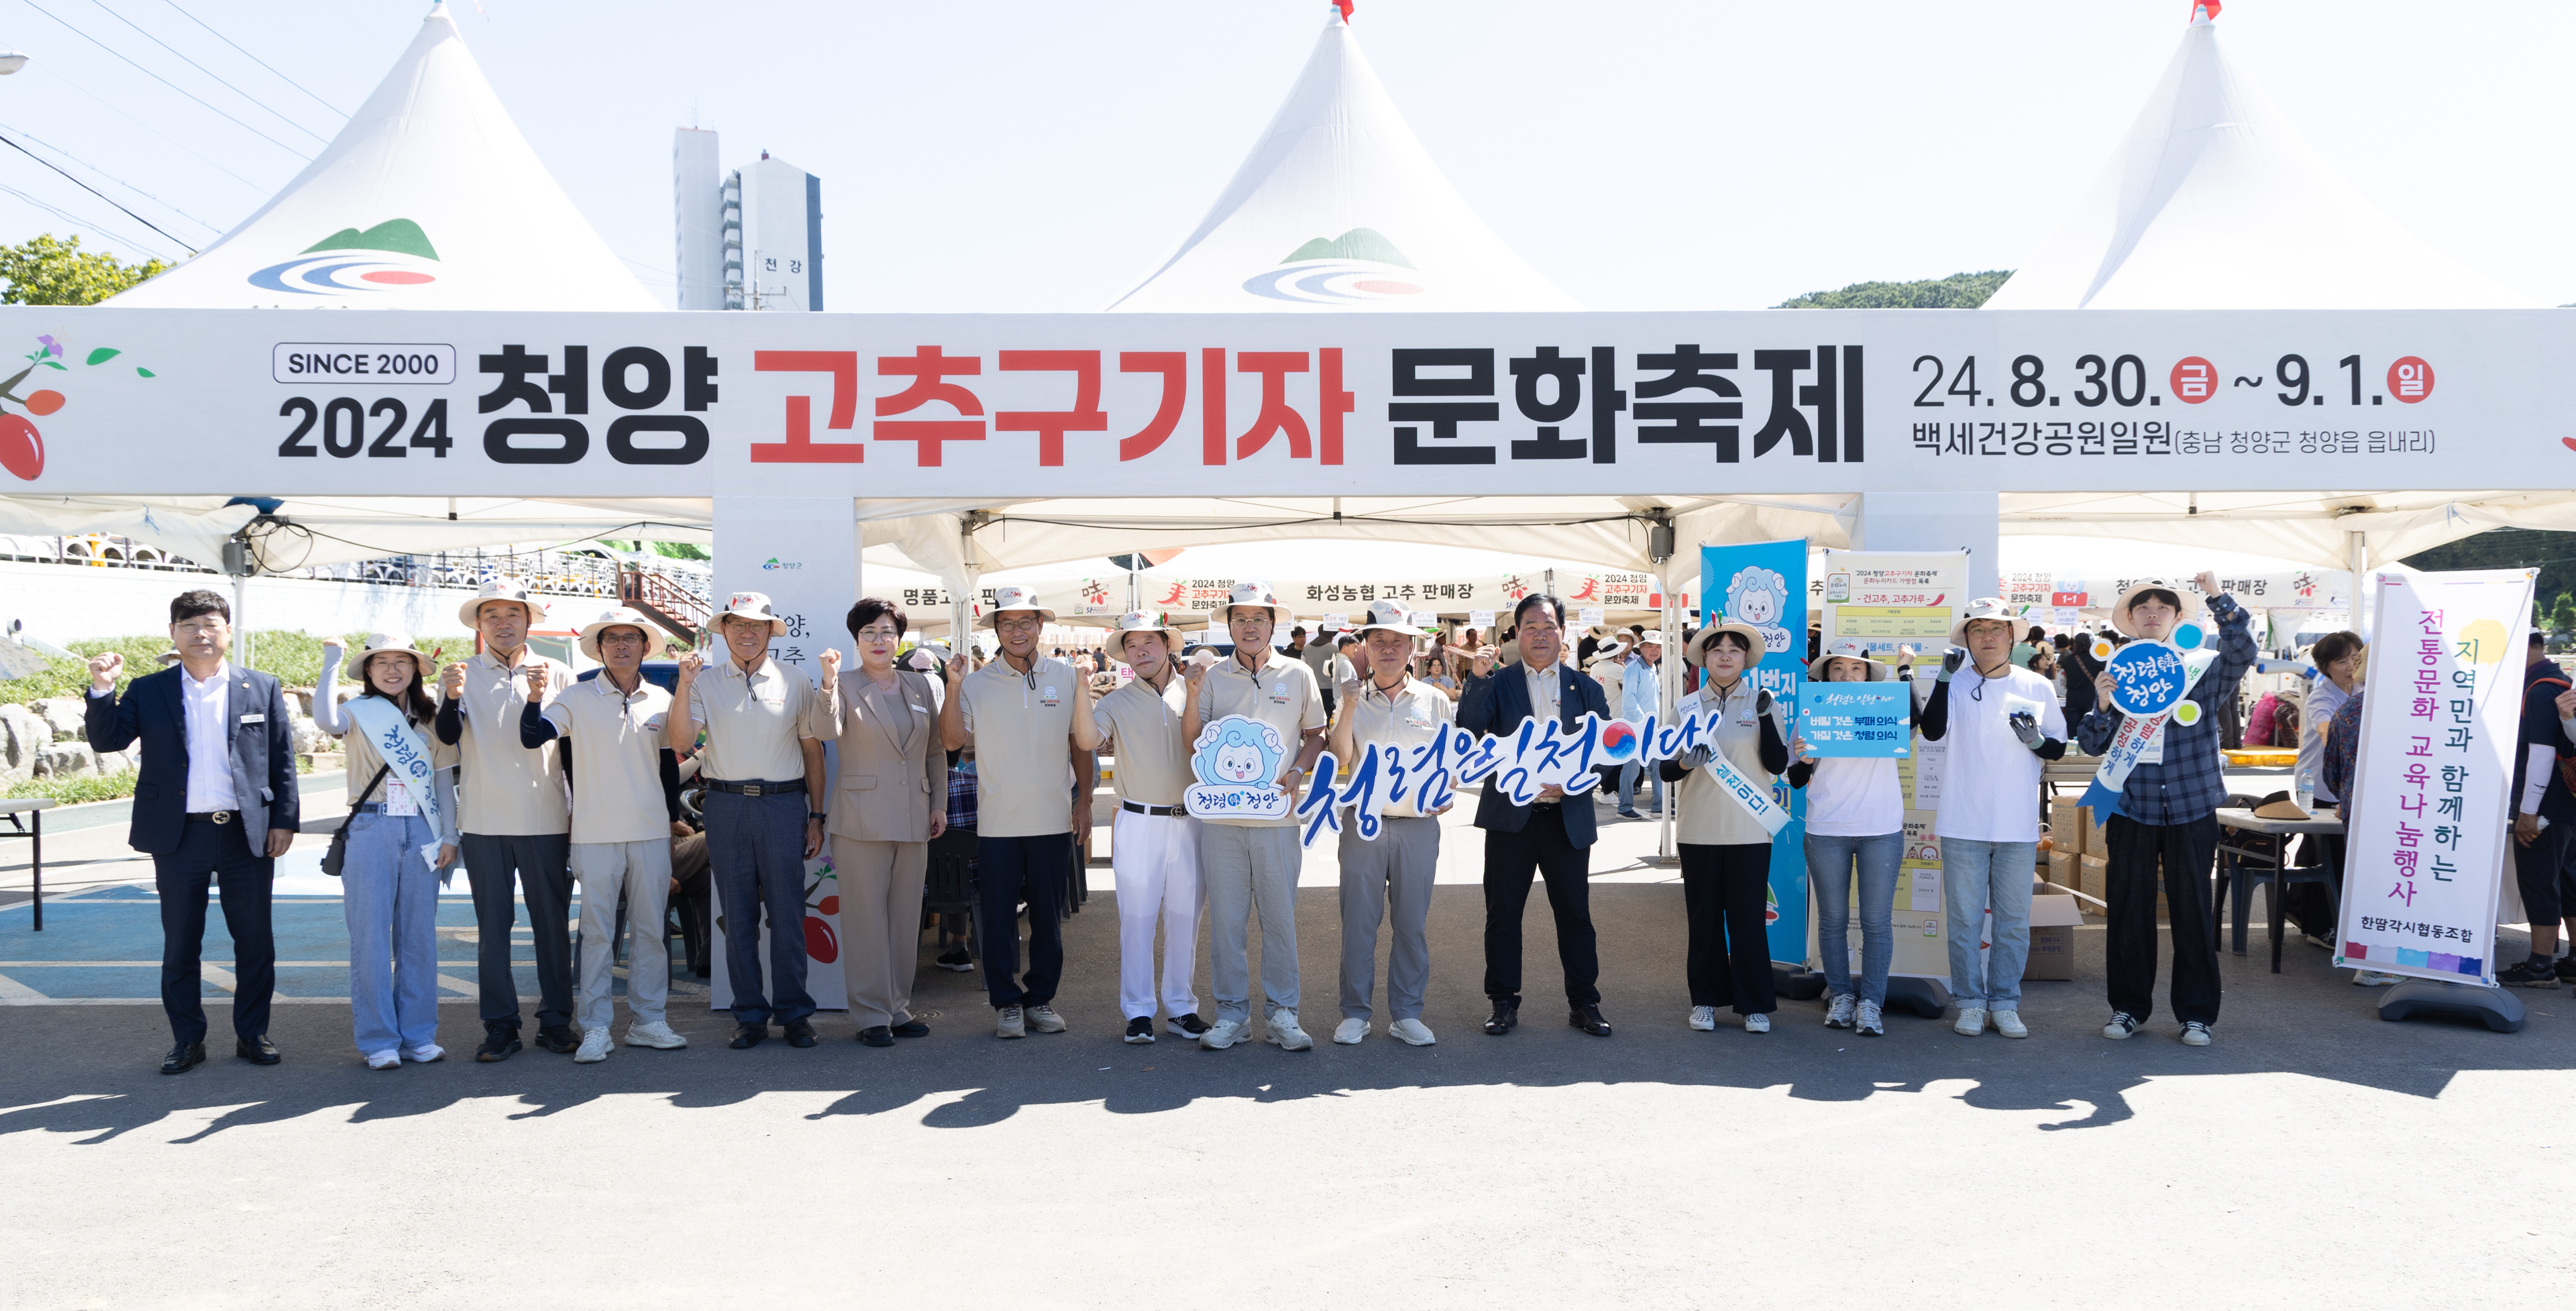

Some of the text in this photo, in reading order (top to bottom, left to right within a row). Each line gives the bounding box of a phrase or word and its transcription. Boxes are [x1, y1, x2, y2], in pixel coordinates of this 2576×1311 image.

[288, 353, 439, 375] SINCE 2000
[1912, 355, 1995, 407] 24.
[2010, 353, 2060, 407] 8.
[2074, 353, 2161, 406] 30.
[2180, 365, 2209, 397] 금
[2275, 353, 2323, 406] 9.
[2339, 353, 2383, 406] 1.
[2398, 363, 2424, 396] 일
[278, 343, 1864, 467] 2024 청양 고추구기자 문화축제
[2229, 429, 2292, 455] 청양군
[2298, 429, 2360, 455] 청양읍
[2367, 429, 2435, 455] 읍내리)
[782, 562, 802, 570] 청양군
[1192, 579, 1235, 588] 2024 청양
[1605, 574, 1647, 583] 2024 청양
[2012, 573, 2051, 581] 2024 청양
[1307, 583, 1474, 602] 화성농협 고추 판매장
[1605, 584, 1648, 594] 고추구기자
[2011, 583, 2051, 593] 고추구기자
[2222, 579, 2268, 595] 판매장
[1605, 595, 1639, 604] 문화축제
[1864, 594, 1925, 604] 건고추, 고추가루
[2010, 594, 2042, 603] 문화축제
[2062, 595, 2077, 603] 1-1
[2410, 608, 2444, 722] 전통문화
[2125, 678, 2174, 707] 청양
[1811, 716, 1897, 726] 버릴 것은 부패 의식
[1811, 730, 1897, 740] 가질 것은 청렴 의식
[2103, 717, 2139, 777] 공정하게
[2430, 638, 2479, 882] 지역민과 함께하는
[1246, 792, 1279, 809] 청양
[2361, 915, 2473, 944] 한땀각시협동조합
